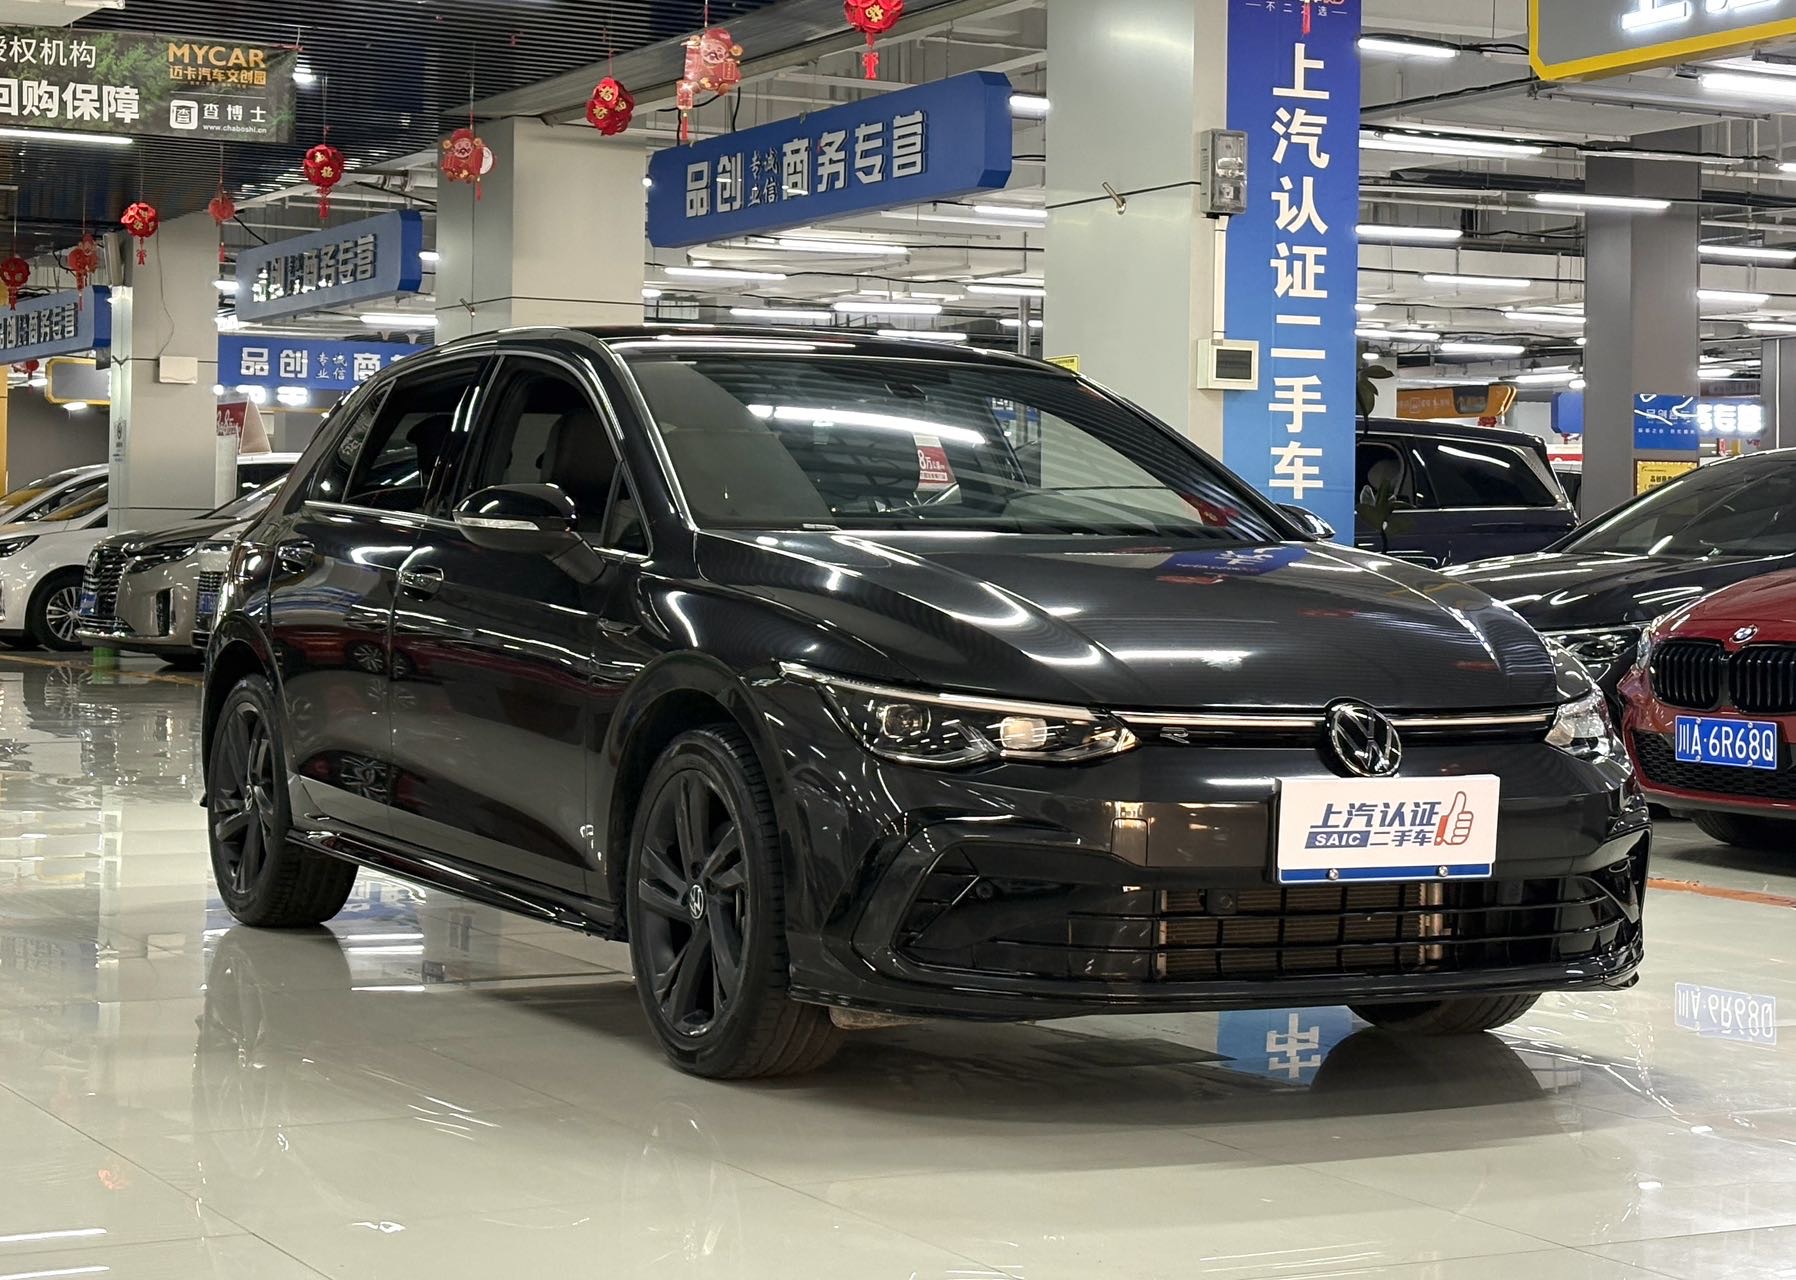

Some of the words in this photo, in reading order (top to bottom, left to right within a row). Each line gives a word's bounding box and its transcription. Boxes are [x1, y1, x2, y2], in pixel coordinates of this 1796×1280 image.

[168, 42, 266, 68] MYCAR
[202, 103, 267, 122] 查博士
[202, 124, 267, 133] www.chaboshi.cn
[686, 153, 745, 218] 品创
[782, 110, 925, 200] 商务专营
[1269, 42, 1330, 500] 上汽认证二手车
[241, 347, 308, 378] 品创
[353, 352, 407, 381] 商
[1309, 801, 1442, 829] 上汽认证
[1314, 832, 1362, 847] SAIC
[1369, 829, 1435, 847] 二手车
